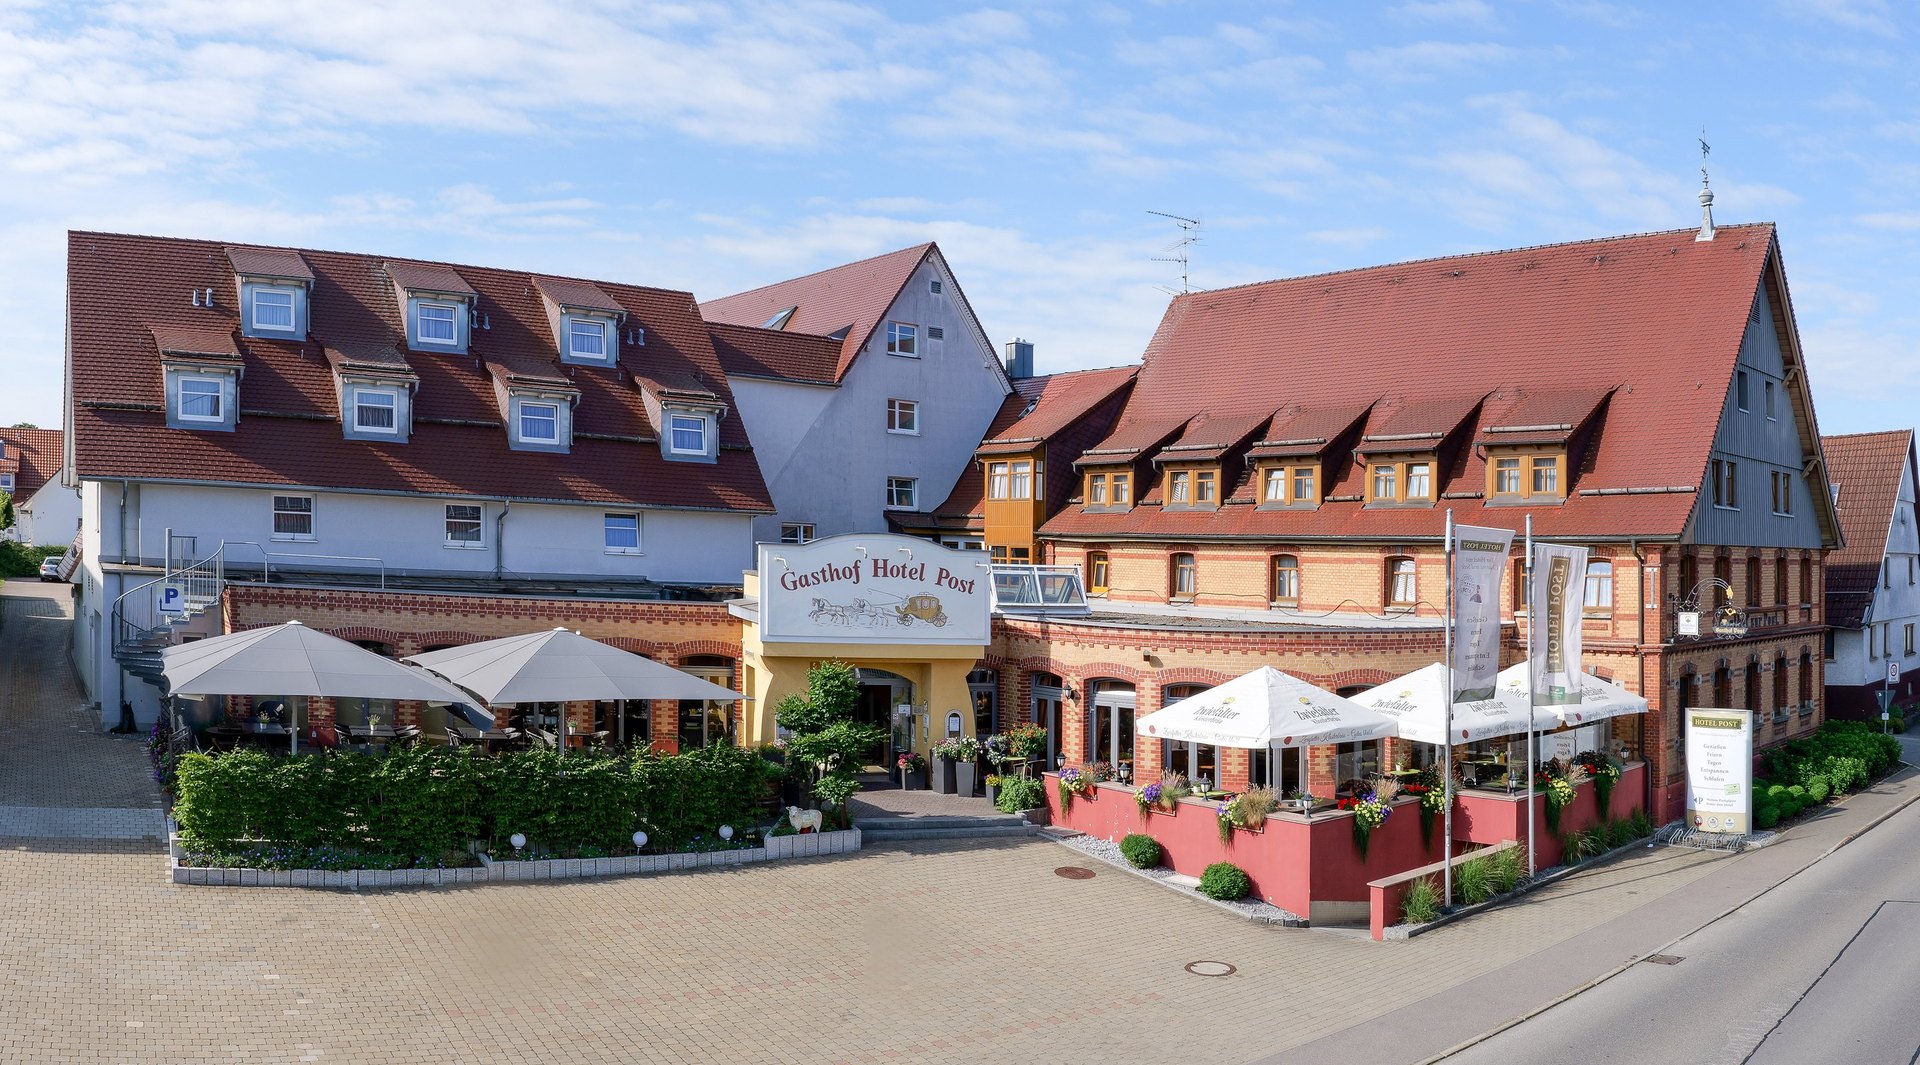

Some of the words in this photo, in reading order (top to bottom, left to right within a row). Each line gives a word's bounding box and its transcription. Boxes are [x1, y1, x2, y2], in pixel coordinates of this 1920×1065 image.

[780, 559, 862, 592] Gasthof
[871, 558, 926, 582] Hotel
[934, 567, 976, 595] Post
[165, 588, 178, 604] P
[1193, 705, 1240, 720] Zwiefalter
[1293, 705, 1340, 720] Zwiefalter
[1371, 699, 1418, 712] Zwiefalter
[1466, 699, 1508, 712] Zwiefalter
[1694, 718, 1718, 727] HOTEL
[1718, 720, 1738, 728] POST
